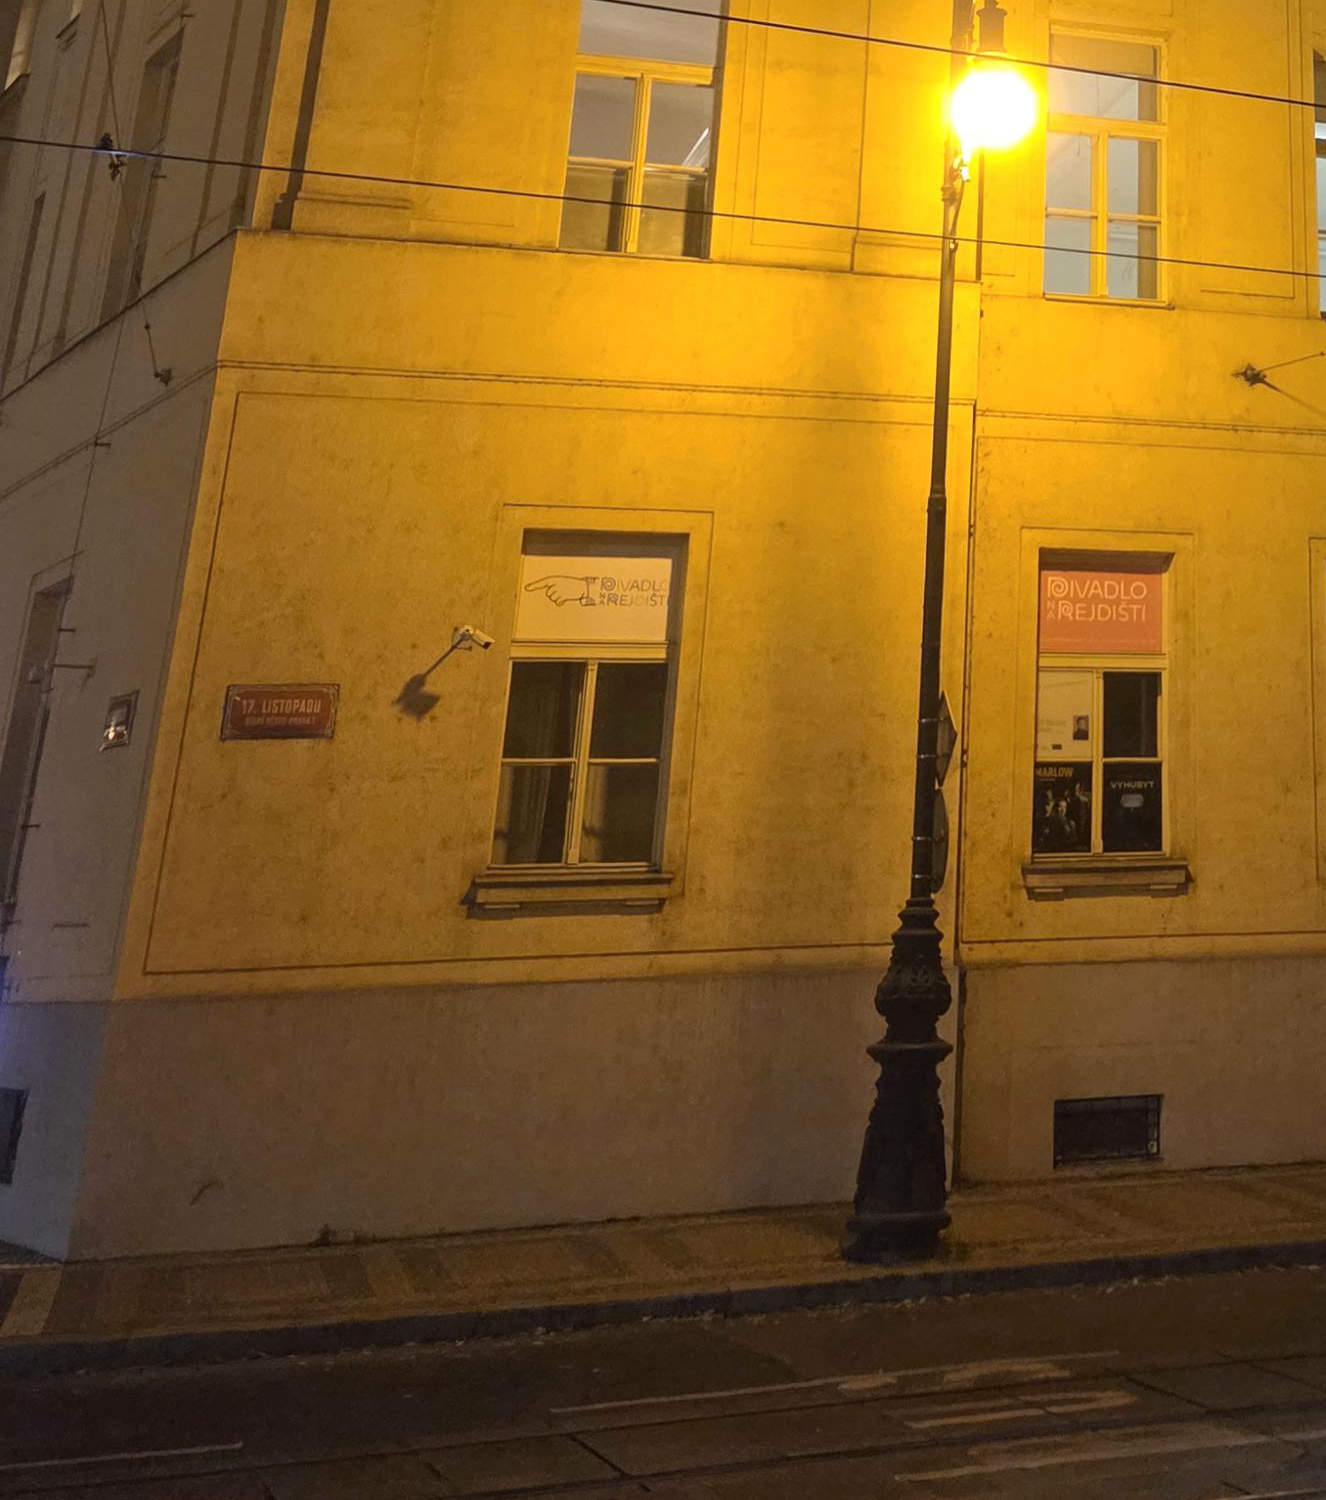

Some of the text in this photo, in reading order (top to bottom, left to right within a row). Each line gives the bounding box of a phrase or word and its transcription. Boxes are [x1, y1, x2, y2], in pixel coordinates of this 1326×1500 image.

[1047, 576, 1148, 600] DIVADLO
[242, 699, 322, 714] 17. LISTOPADU
